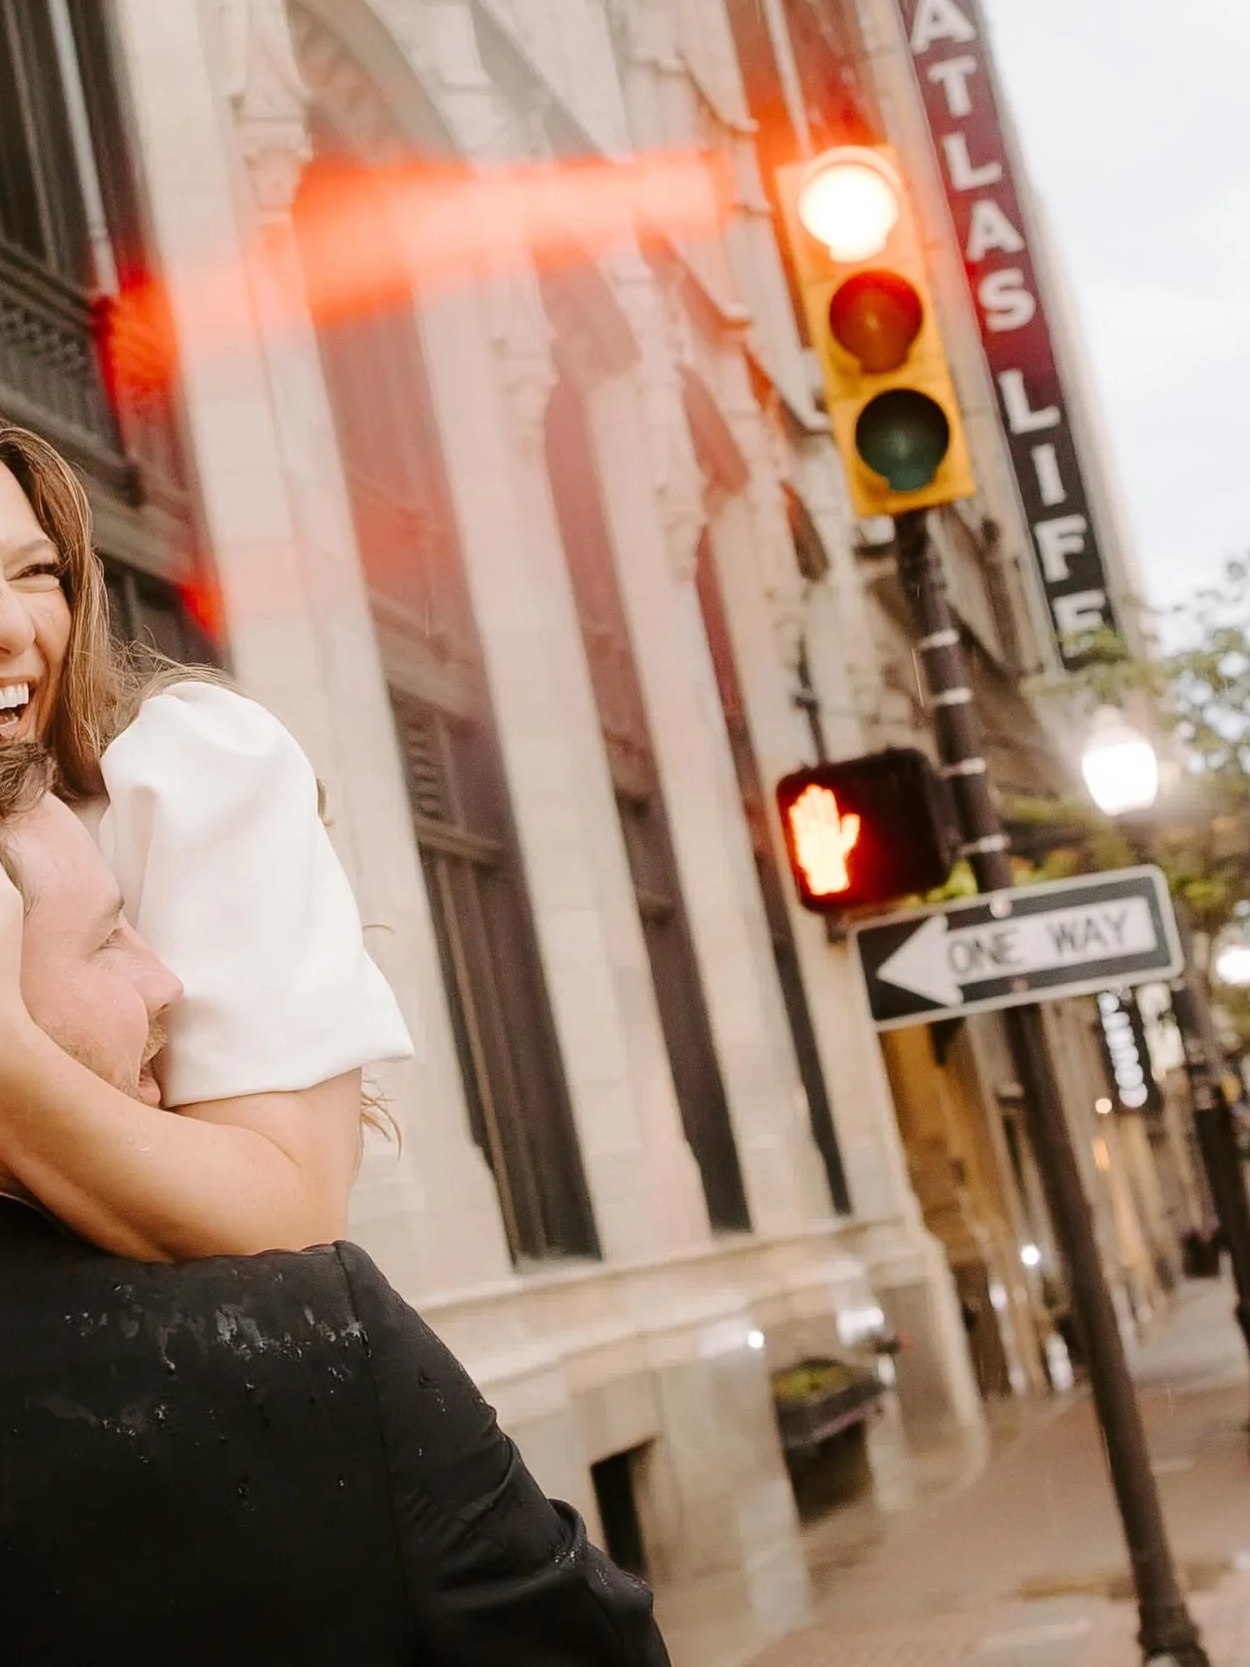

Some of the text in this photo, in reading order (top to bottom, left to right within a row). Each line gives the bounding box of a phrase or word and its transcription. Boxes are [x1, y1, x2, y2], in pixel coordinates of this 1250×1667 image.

[998, 369, 1112, 664] LIFE
[947, 908, 1129, 976] ONE WAY
